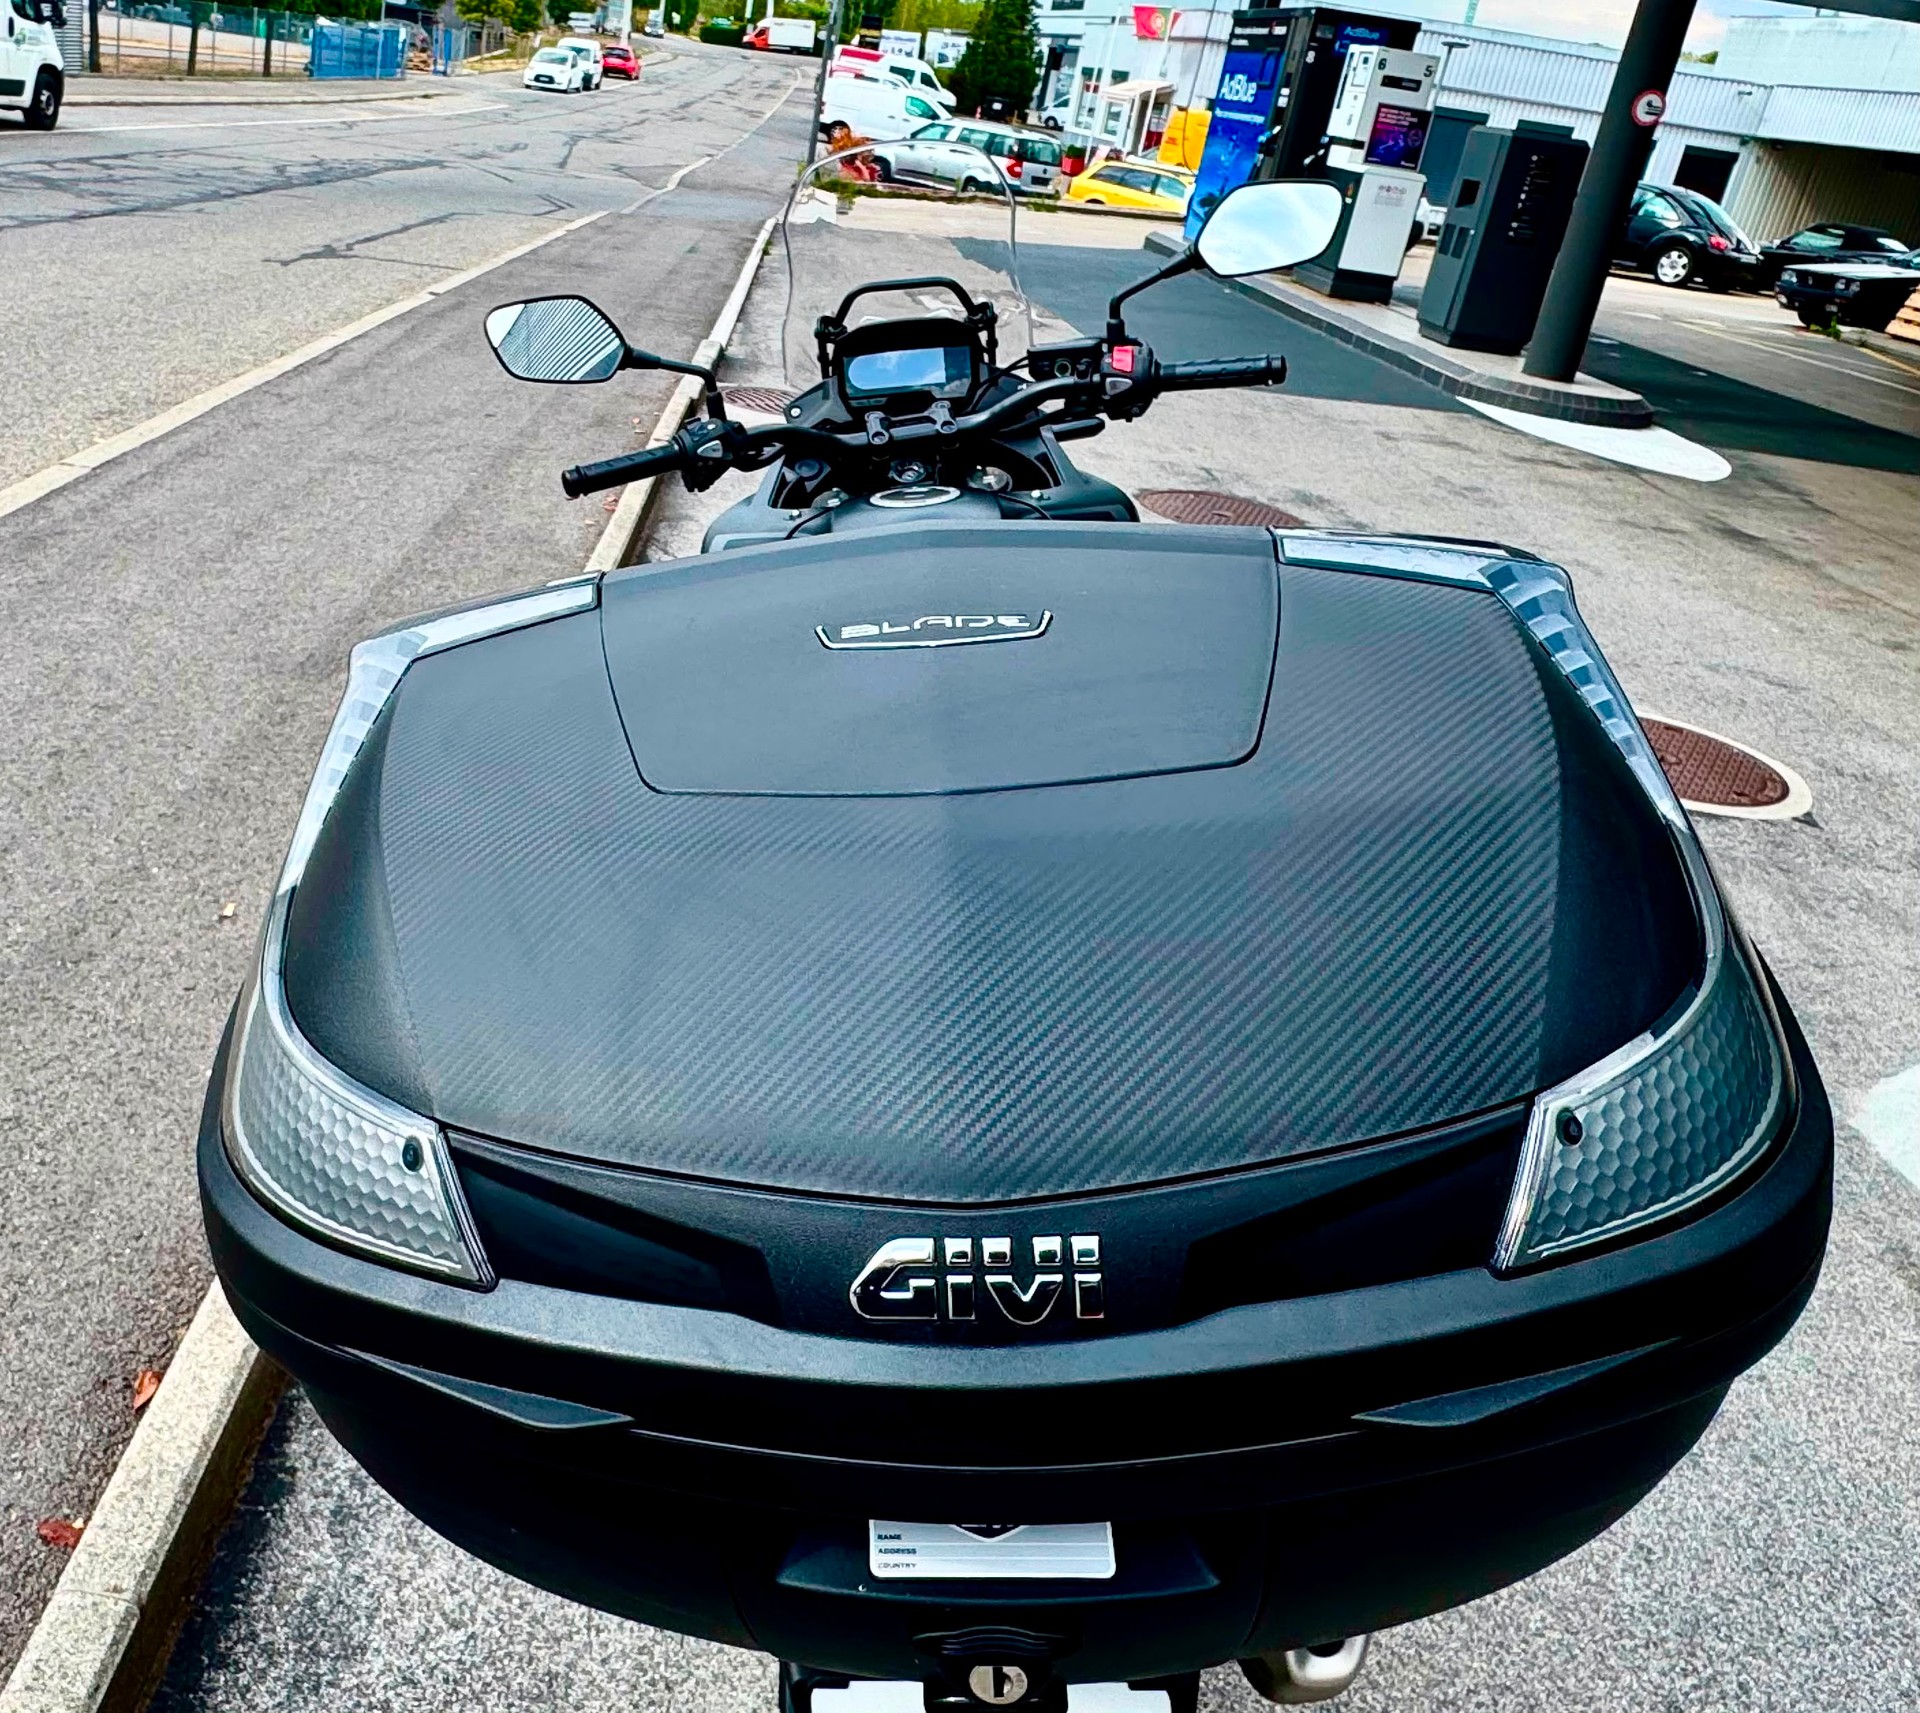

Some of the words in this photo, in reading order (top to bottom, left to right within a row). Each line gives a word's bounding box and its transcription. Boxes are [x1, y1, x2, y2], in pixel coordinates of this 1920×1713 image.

[1377, 58, 1387, 71] 6
[1423, 65, 1433, 78] 5
[1219, 73, 1257, 103] AdBlue
[840, 615, 1031, 639] BLADE
[849, 1234, 1105, 1326] GIVI
[877, 1533, 902, 1541] NAME
[878, 1547, 917, 1555] ADDRESS
